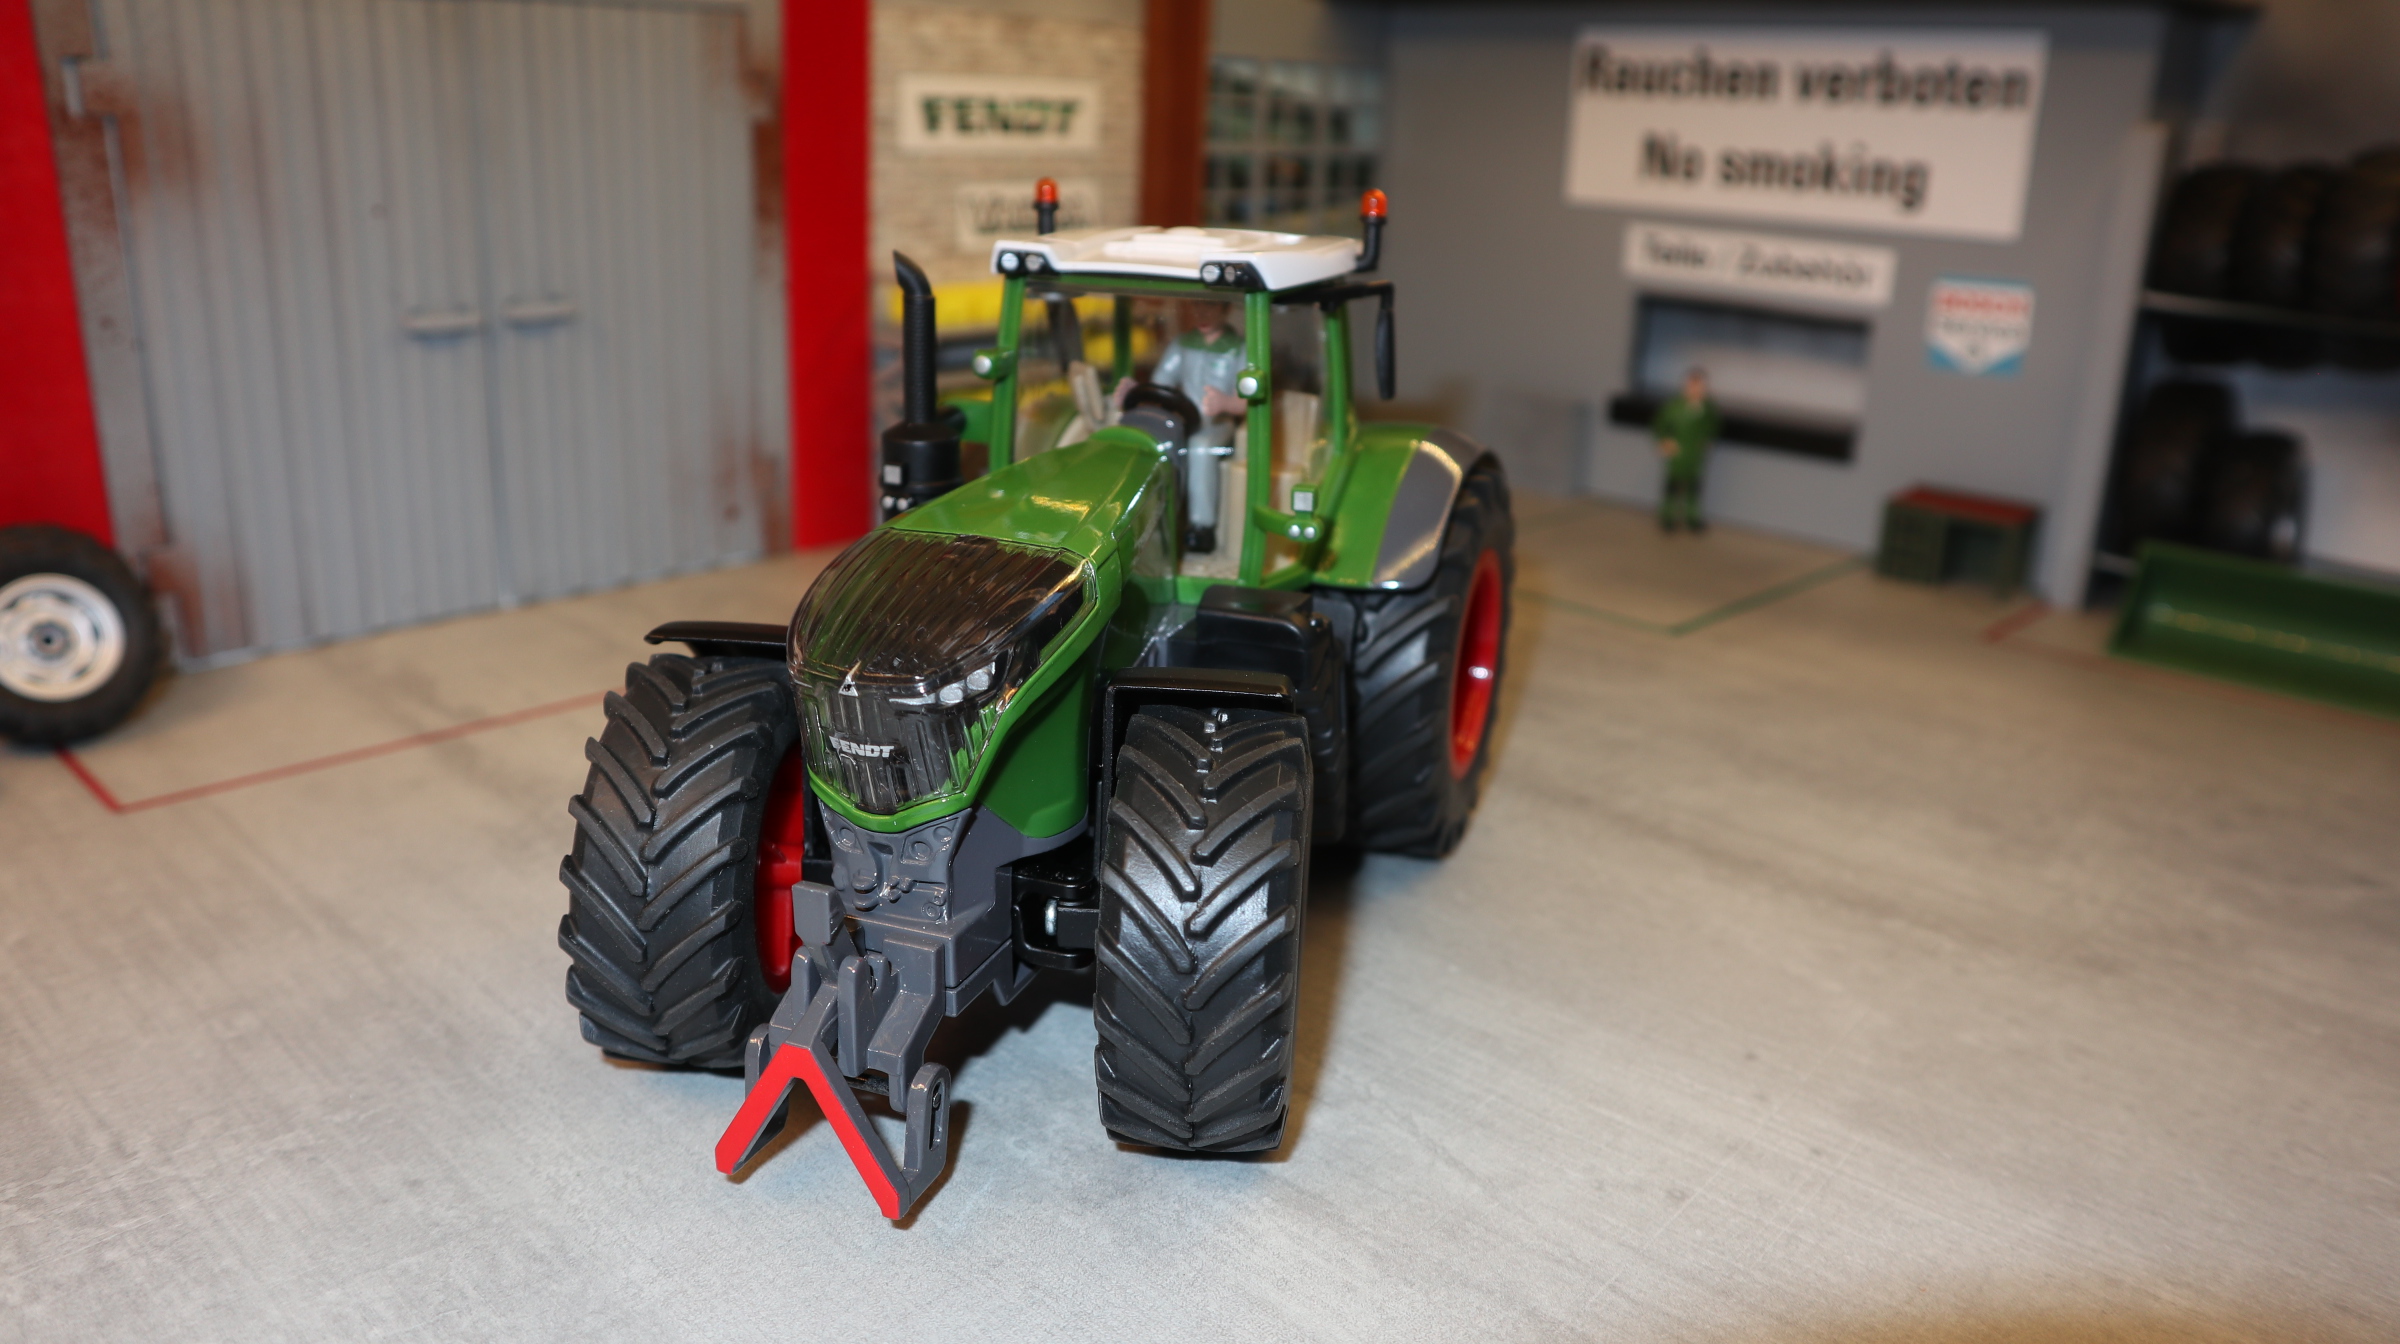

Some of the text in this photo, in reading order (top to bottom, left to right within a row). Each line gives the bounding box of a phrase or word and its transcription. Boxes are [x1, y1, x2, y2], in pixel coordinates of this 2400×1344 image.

[1581, 45, 2028, 105] Rauchen verboten
[1641, 134, 1929, 210] No smoking
[829, 736, 895, 758] FENDT
